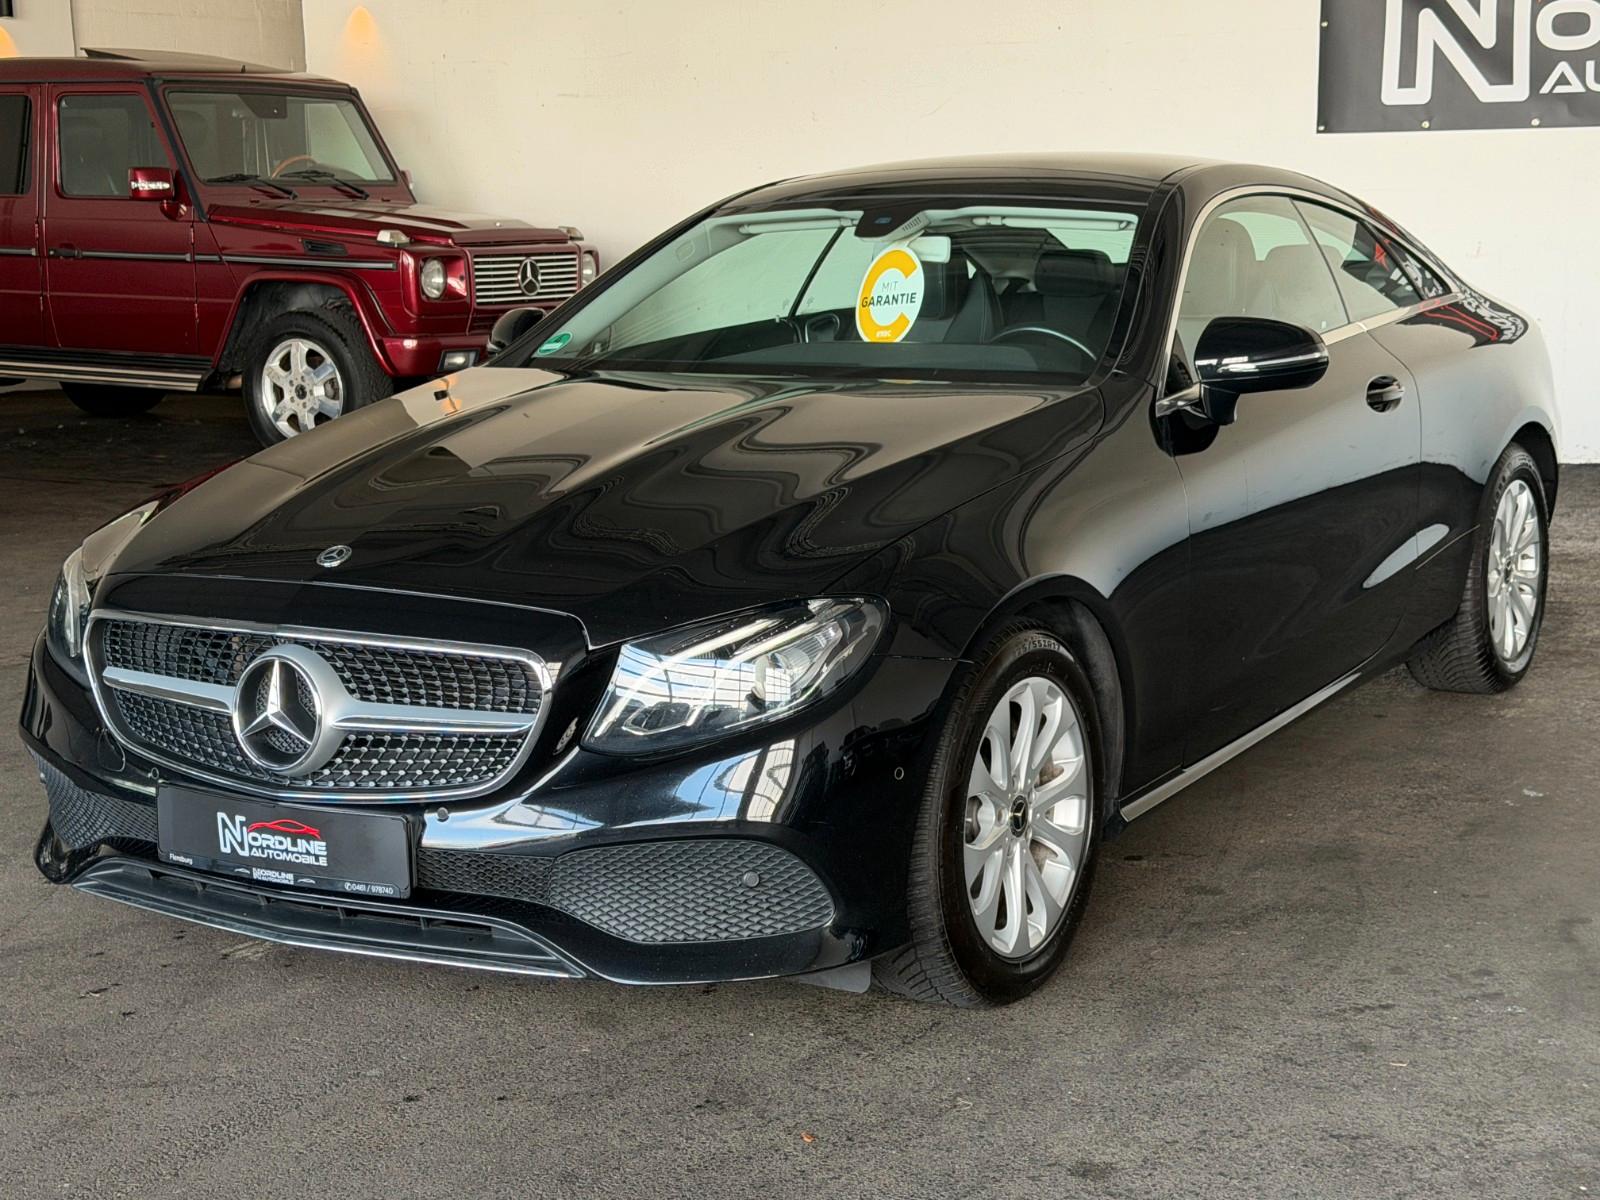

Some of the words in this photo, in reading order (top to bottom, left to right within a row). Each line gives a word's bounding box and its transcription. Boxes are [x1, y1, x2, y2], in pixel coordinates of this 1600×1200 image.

[881, 280, 899, 292] MIT
[861, 292, 917, 308] GARANTIE
[217, 812, 327, 857] NORDLINE
[250, 847, 328, 867] AUTOMOBILE
